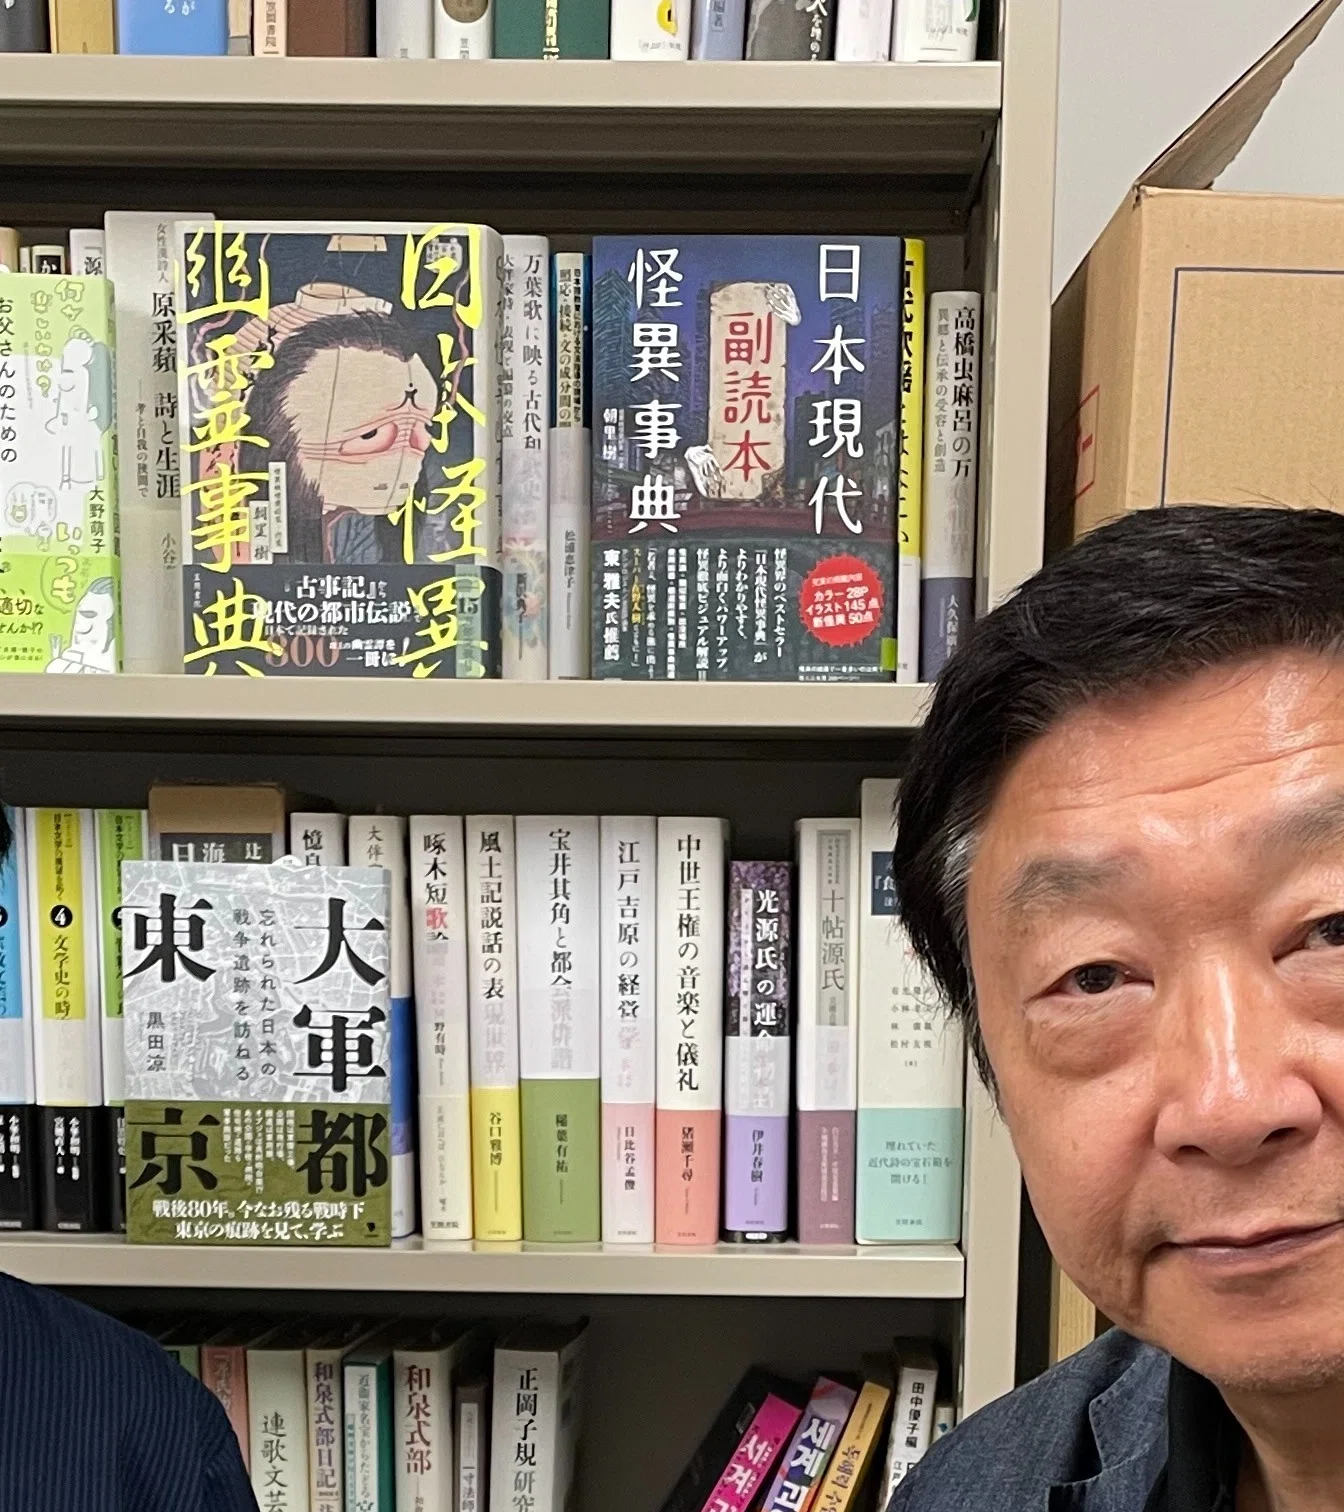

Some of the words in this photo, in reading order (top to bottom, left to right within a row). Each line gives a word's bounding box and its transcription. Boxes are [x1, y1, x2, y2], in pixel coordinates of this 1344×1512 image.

[627, 247, 684, 534] 怪異事典
[722, 312, 773, 482] 副読本
[808, 244, 866, 535] 日本現代
[89, 486, 106, 554] 大野萌子
[231, 909, 252, 1082] 戦争遺跡を訪ねる
[259, 909, 277, 1077] 忘れられた日本の
[676, 834, 701, 1092] 中世王権の音楽と儀礼
[821, 889, 846, 992] 十帖源氏
[122, 893, 221, 1195] 東京
[293, 897, 389, 1197] 大軍都
[489, 1112, 503, 1166] 谷口雅博
[313, 1361, 338, 1488] 和泉式部日記
[404, 1364, 433, 1476] 和泉式部
[790, 1416, 837, 1479] 세계
[908, 1381, 925, 1450] 田中優子編
